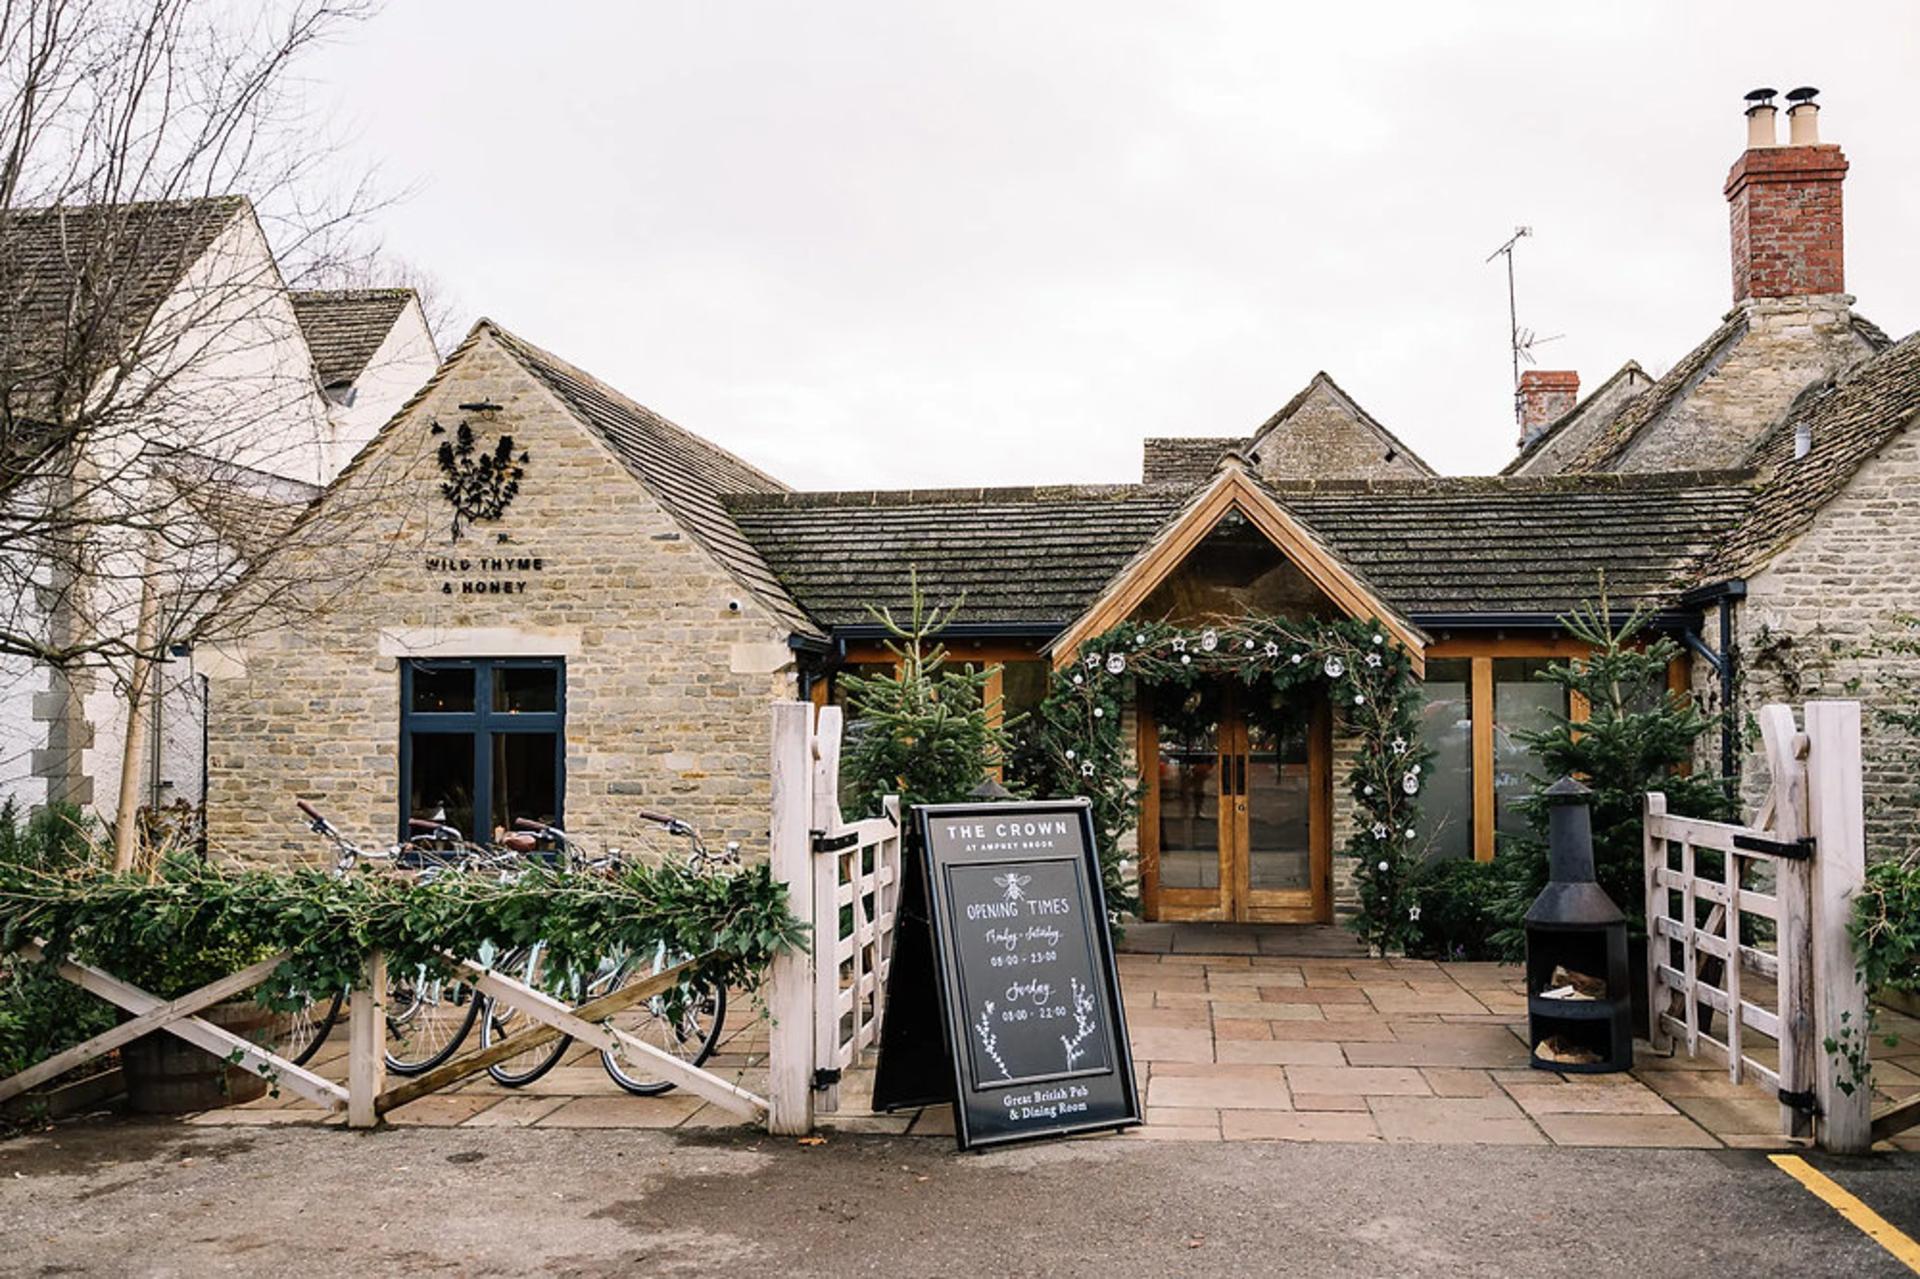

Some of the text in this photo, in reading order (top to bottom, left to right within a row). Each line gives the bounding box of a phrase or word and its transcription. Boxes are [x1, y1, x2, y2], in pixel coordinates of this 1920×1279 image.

[425, 558, 543, 571] WILD THYME
[442, 581, 527, 594] & HONEY
[946, 821, 1068, 840] THE CROWN
[965, 843, 977, 852] AT
[1022, 840, 1054, 850] BROOK
[966, 898, 1070, 920] OPENING TIMES
[1003, 1085, 1089, 1107] Great British Pub
[1009, 1101, 1088, 1121] & Dining Room
